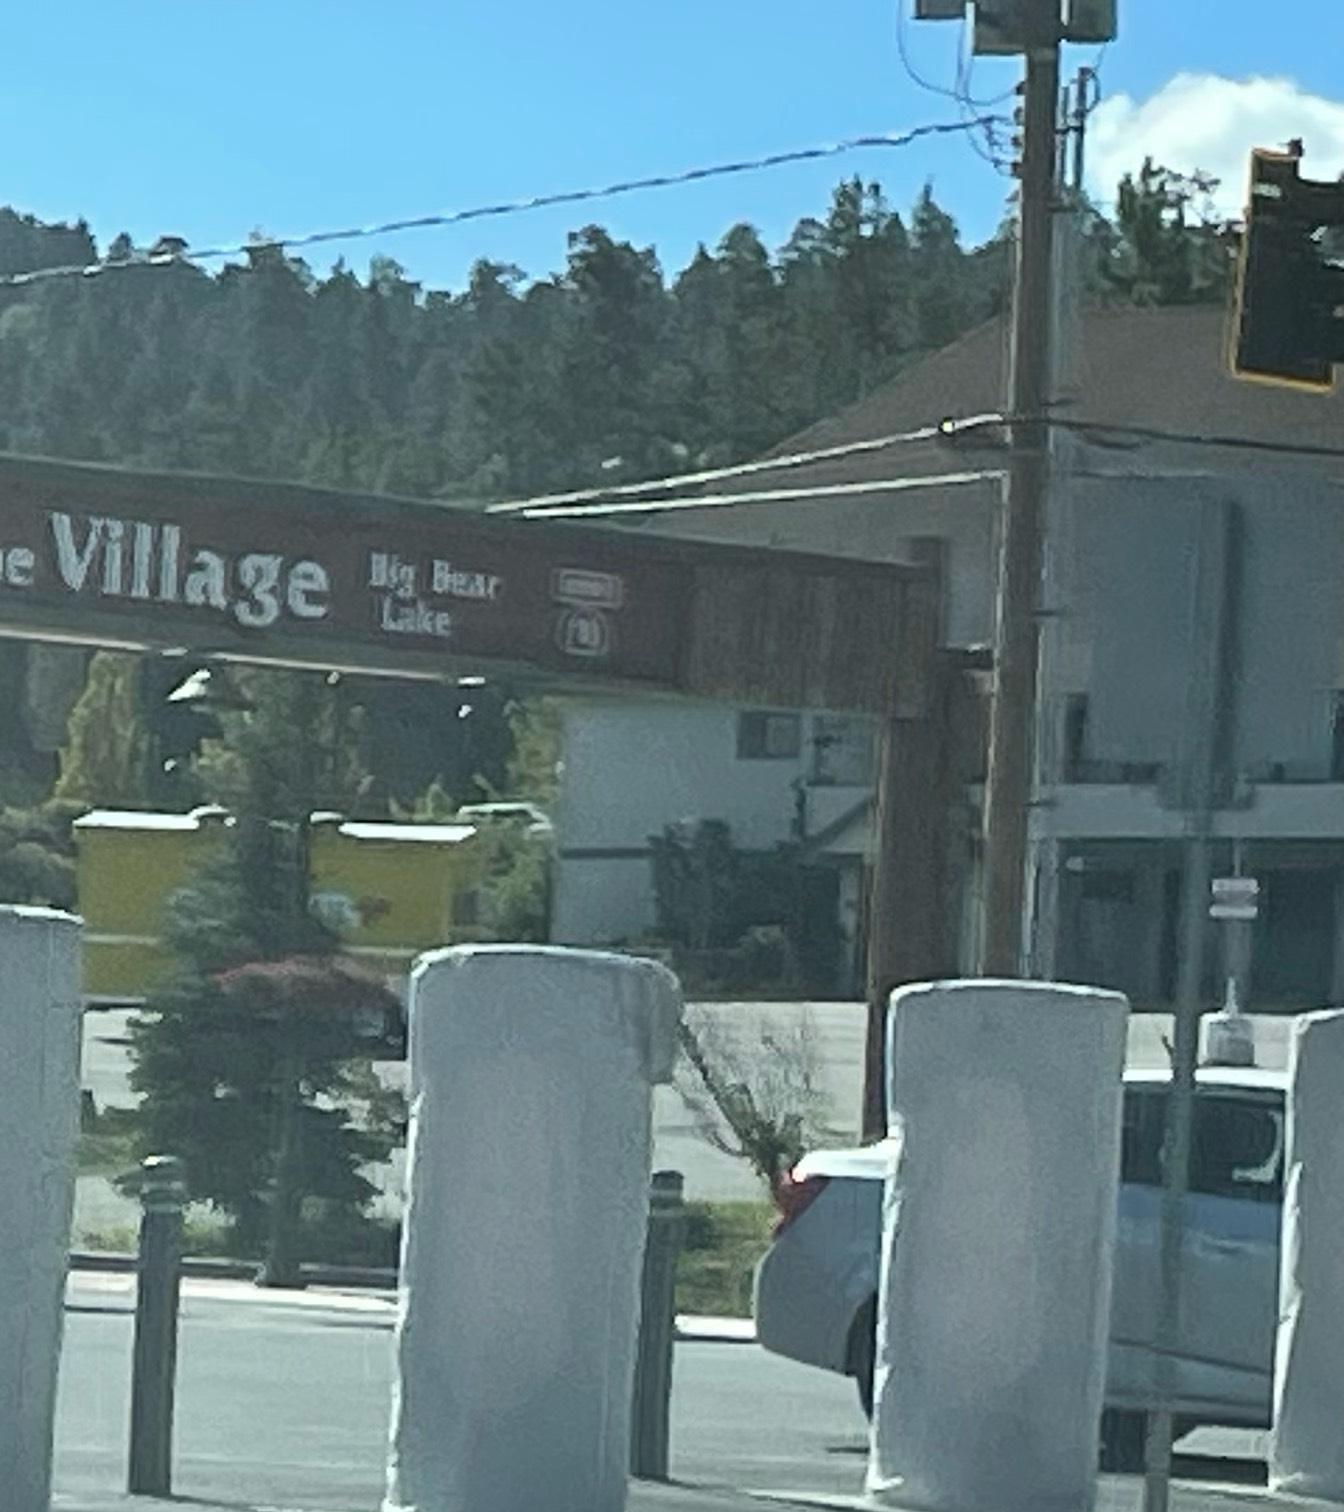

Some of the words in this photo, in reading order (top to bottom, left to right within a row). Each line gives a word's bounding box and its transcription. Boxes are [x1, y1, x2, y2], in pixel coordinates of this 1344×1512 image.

[48, 510, 330, 627] Village
[432, 559, 502, 600] Bear
[381, 596, 451, 636] Lake
